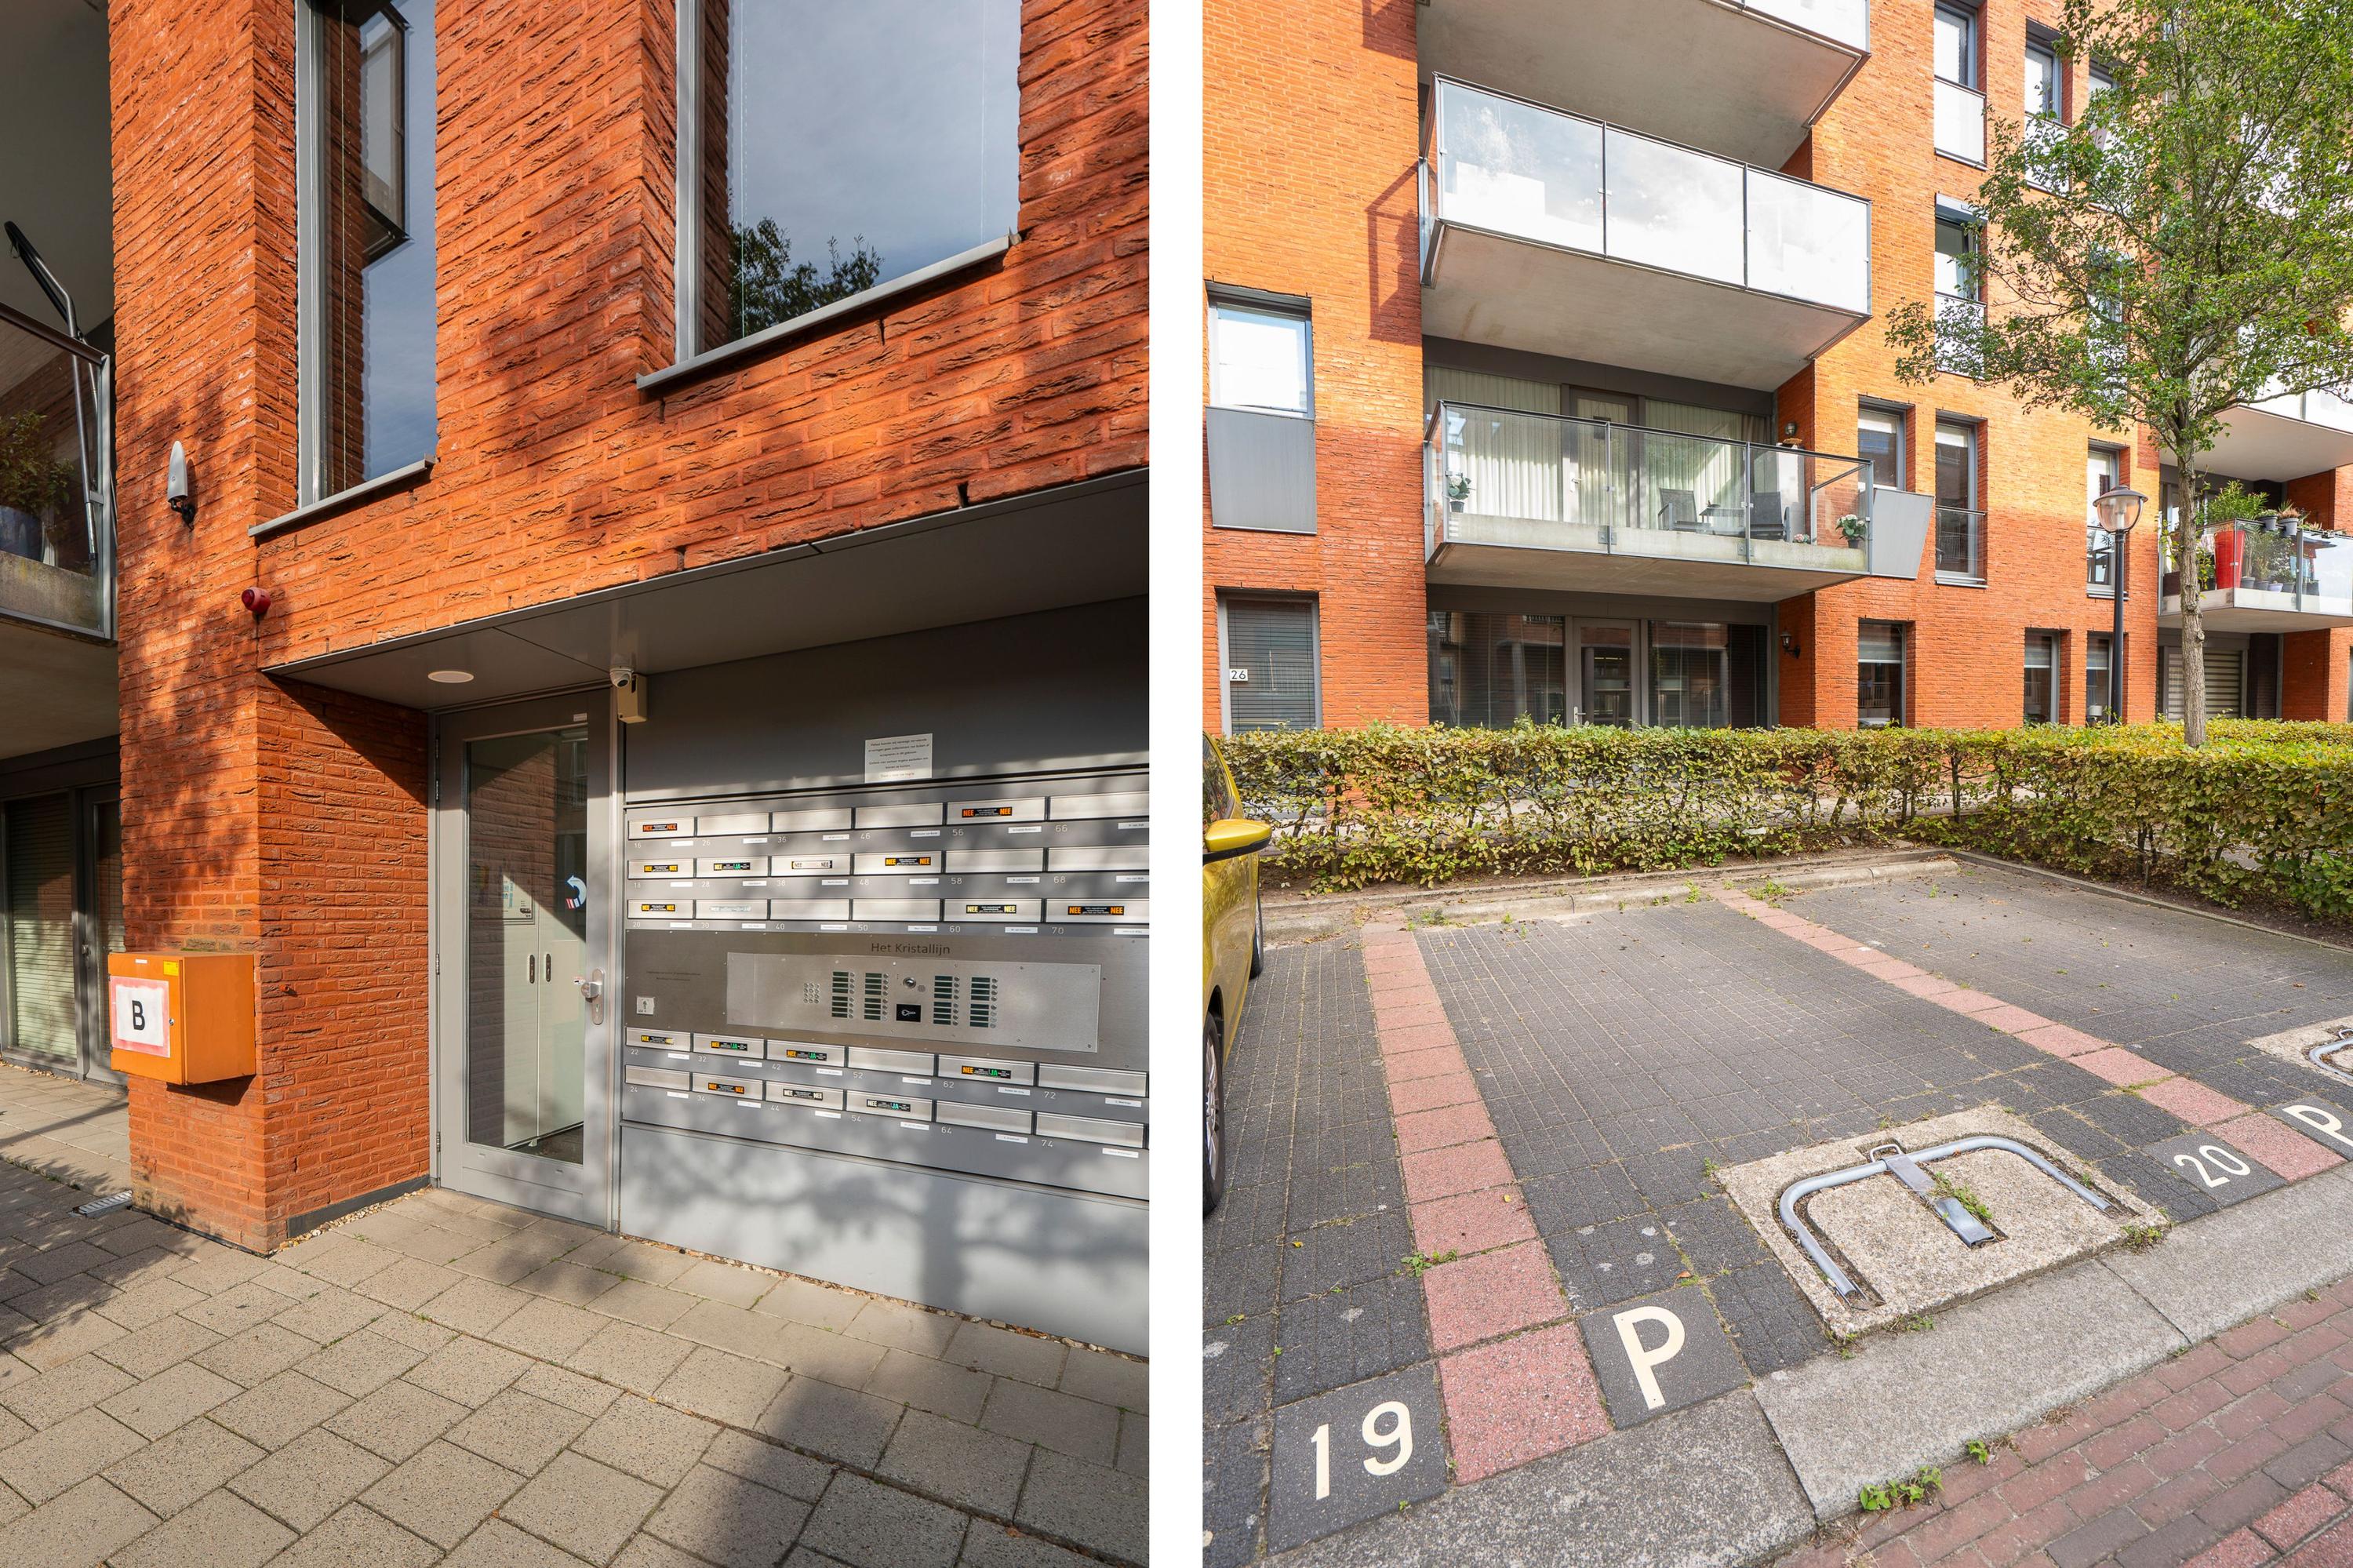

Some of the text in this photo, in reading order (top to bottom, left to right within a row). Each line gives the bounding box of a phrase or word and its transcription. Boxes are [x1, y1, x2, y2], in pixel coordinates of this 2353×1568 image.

[1231, 671, 1246, 680] 26
[871, 943, 950, 955] Het Kristallijn
[132, 1000, 146, 1031] B
[1044, 1091, 1056, 1100] 72
[2282, 1104, 2353, 1148] P
[2173, 1145, 2250, 1188] 20
[1613, 1305, 1686, 1410] P
[1311, 1401, 1413, 1501] 19
